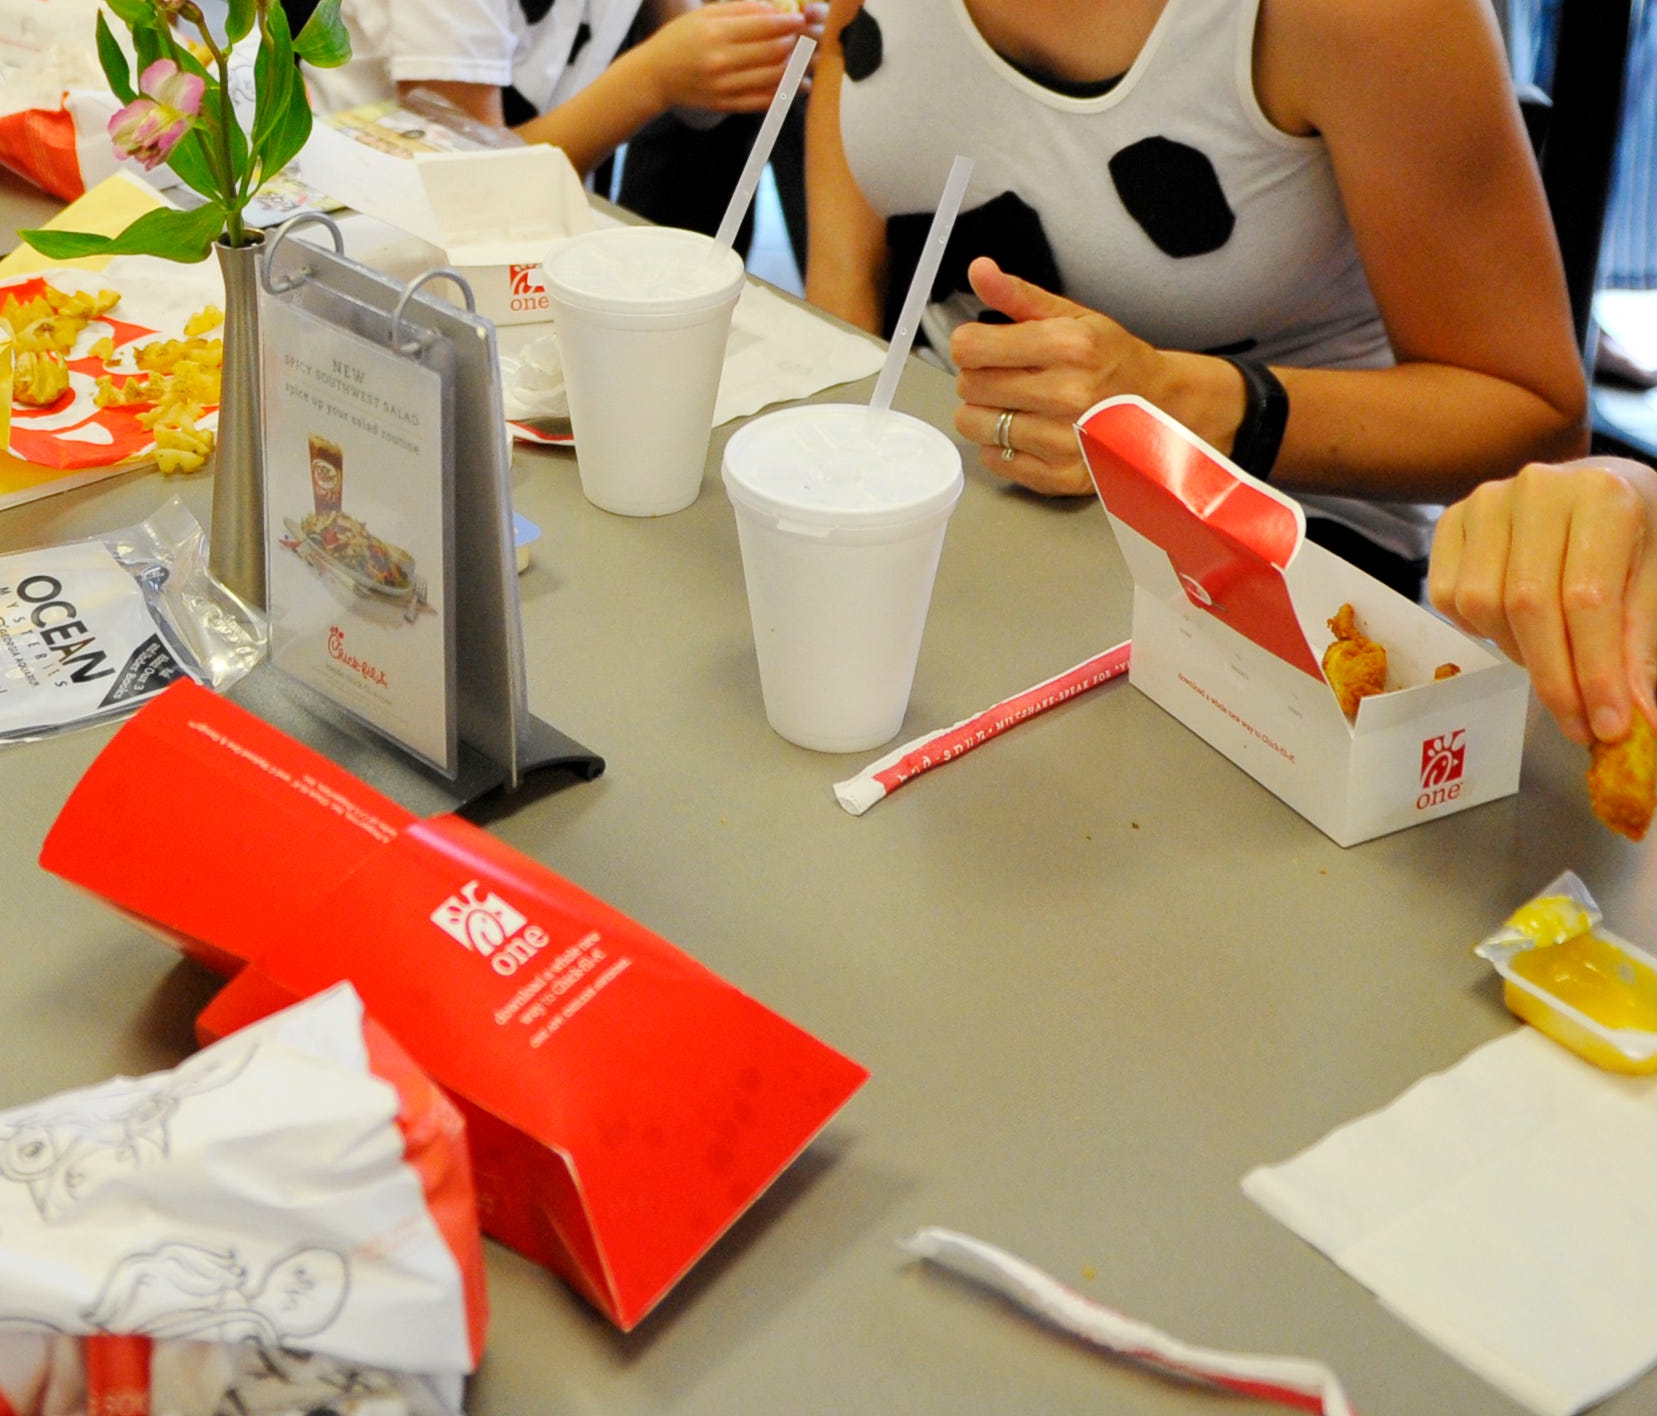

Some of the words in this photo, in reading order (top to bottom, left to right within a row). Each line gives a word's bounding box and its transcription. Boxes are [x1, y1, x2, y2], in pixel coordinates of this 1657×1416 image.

[510, 295, 549, 312] one
[331, 358, 365, 383] NEW
[384, 399, 420, 426] SALAD
[0, 585, 68, 689] MYSTERIES
[17, 575, 115, 683] OCEAN
[14, 655, 40, 688] AQUARIUM
[329, 626, 390, 689] Chick-fil-A
[112, 671, 136, 698] Books
[137, 667, 155, 683] Our
[1091, 669, 1112, 685] FOR
[1178, 672, 1205, 696] download
[1211, 697, 1227, 713] whole
[1228, 710, 1241, 722] new
[1241, 721, 1254, 734] way
[1416, 782, 1463, 810] one
[491, 925, 550, 976] one
[494, 975, 547, 1025] download
[542, 969, 554, 982] a
[553, 946, 583, 973] whole
[577, 931, 601, 952] new
[519, 1002, 547, 1025] way
[541, 991, 557, 1006] to
